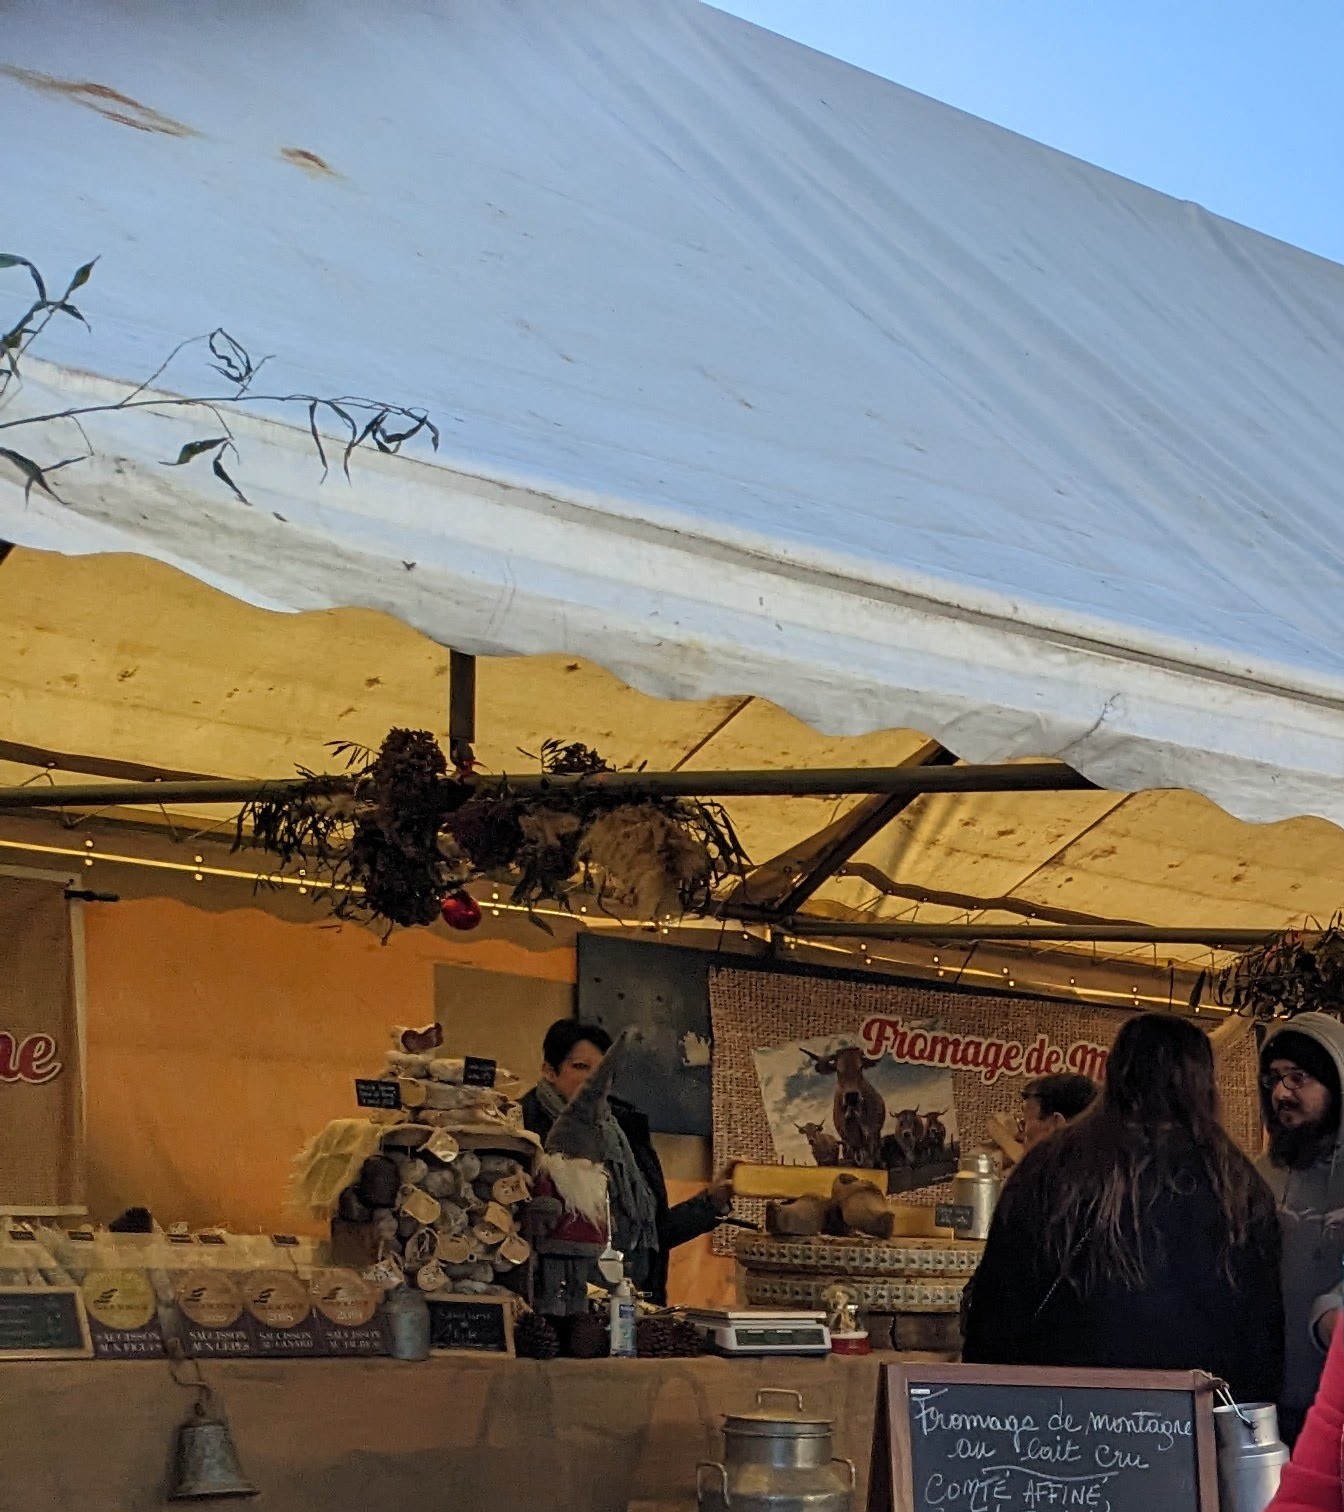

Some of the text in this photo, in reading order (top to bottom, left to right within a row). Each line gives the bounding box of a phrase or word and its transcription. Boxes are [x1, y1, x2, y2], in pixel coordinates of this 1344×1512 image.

[861, 1016, 1023, 1084] Fromage
[1024, 1036, 1064, 1075] de
[912, 1388, 1040, 1454] Fromage
[1048, 1397, 1083, 1432] de
[948, 1438, 997, 1460] au
[1021, 1435, 1082, 1462] lait
